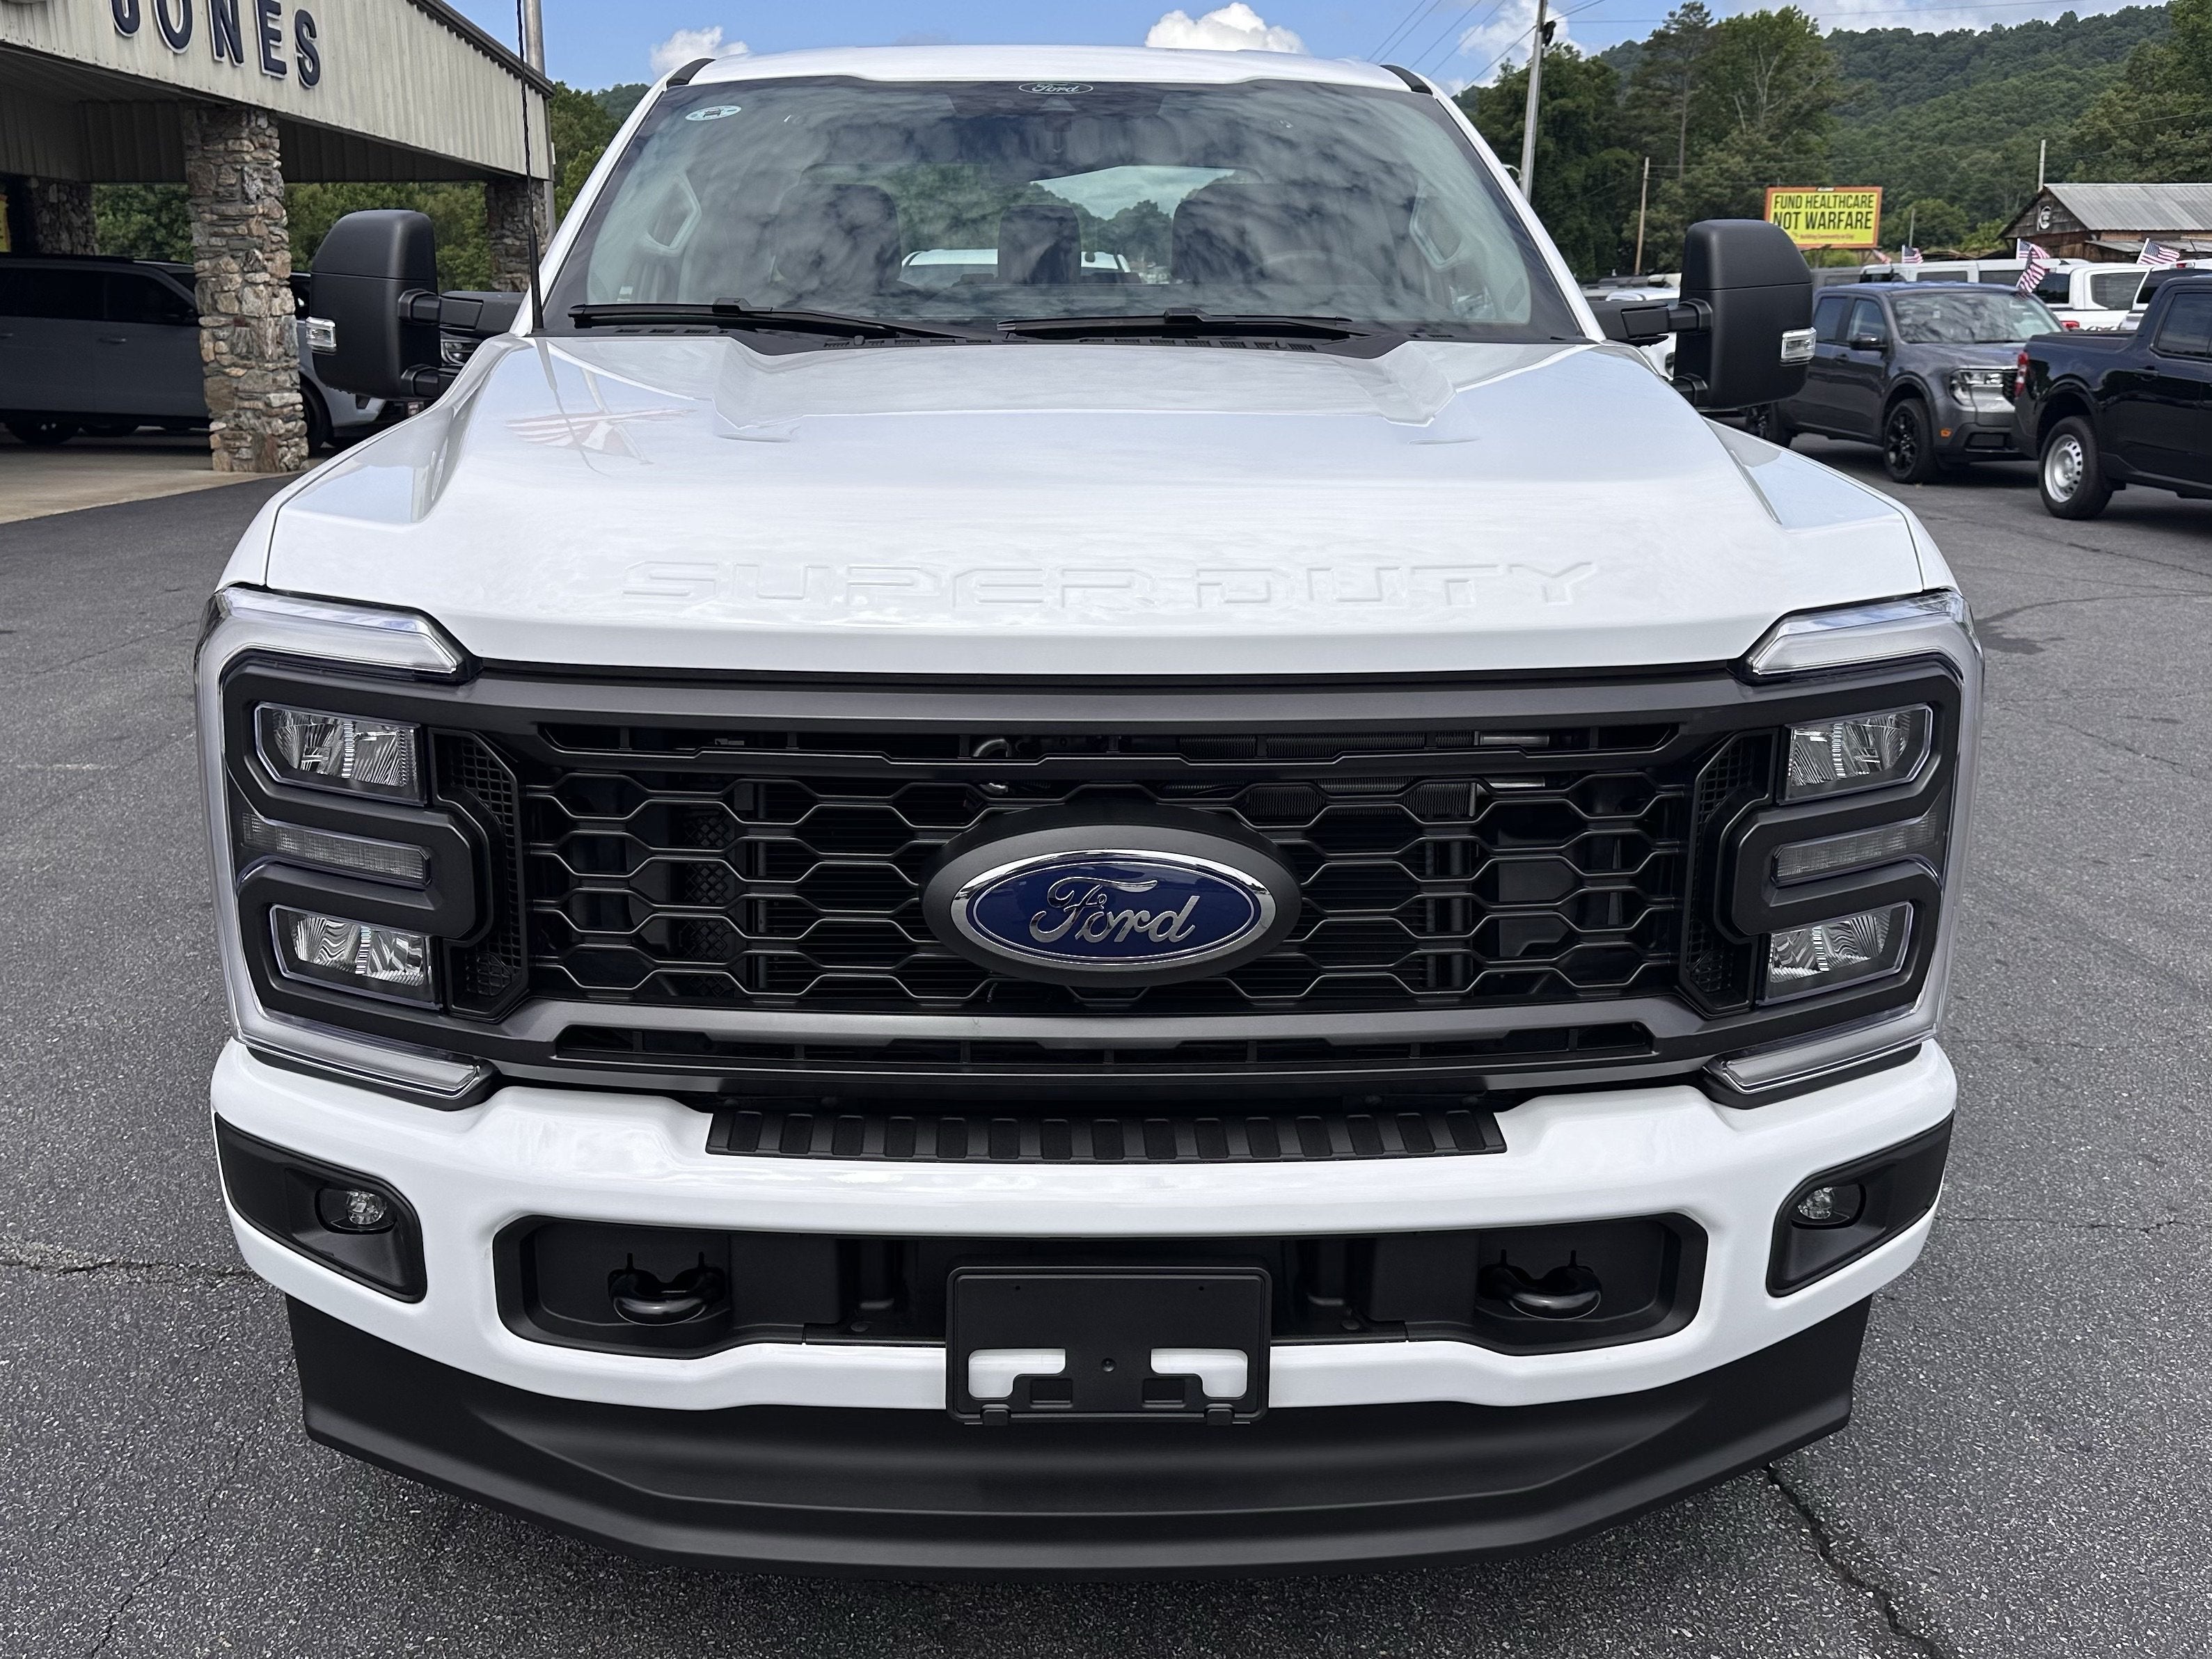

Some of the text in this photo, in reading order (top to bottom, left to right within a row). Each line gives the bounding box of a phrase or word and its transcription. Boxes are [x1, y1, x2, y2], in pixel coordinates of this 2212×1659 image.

[1032, 84, 1080, 92] Ford
[1774, 194, 1874, 209] FUND HEALTHCARE
[1773, 211, 1873, 230] NOT WARFARE
[620, 560, 1597, 609] SUPER DUTY
[1029, 876, 1200, 943] Ford
